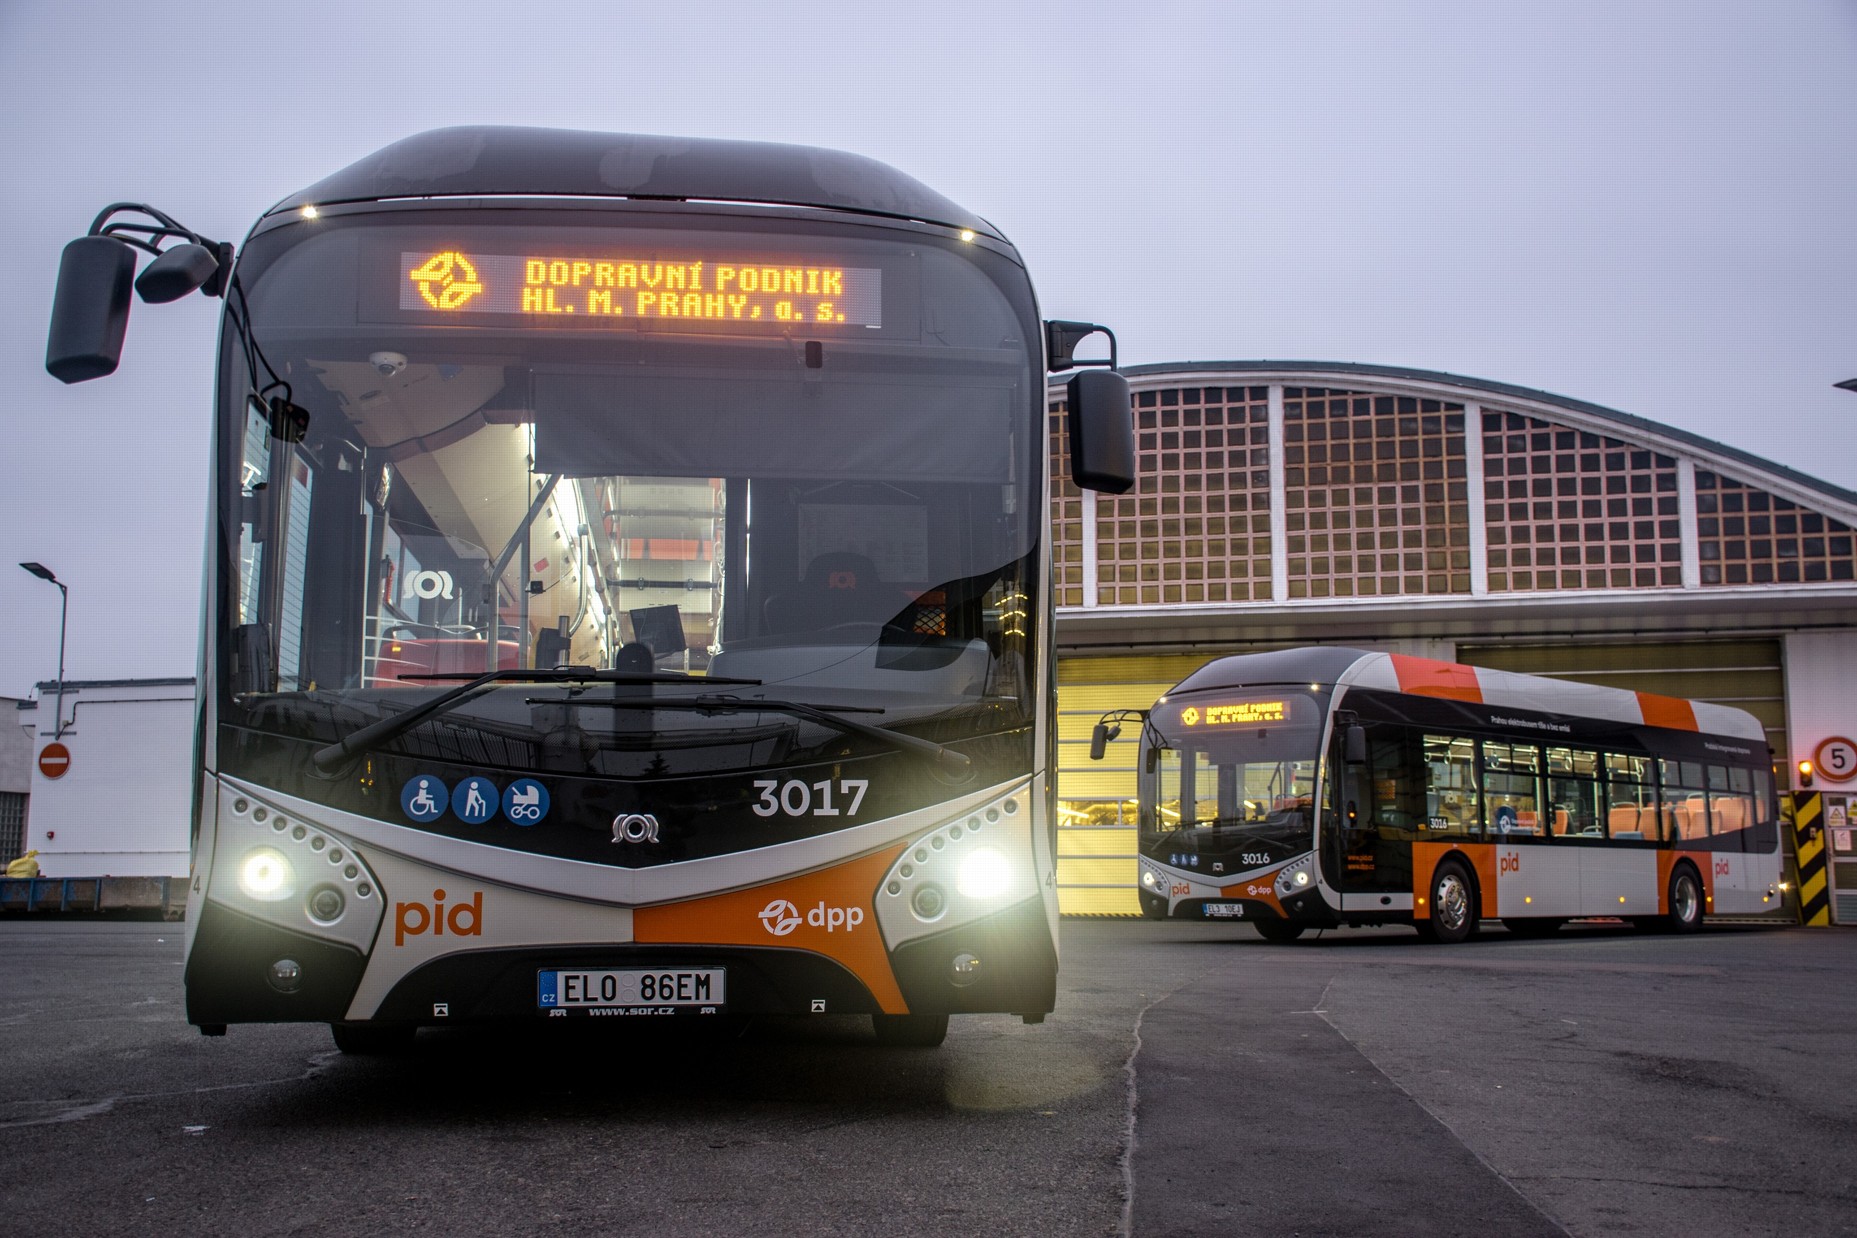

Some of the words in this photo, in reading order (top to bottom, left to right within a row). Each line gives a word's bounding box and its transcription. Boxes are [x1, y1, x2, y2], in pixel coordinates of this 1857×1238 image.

[526, 260, 703, 290] DOPRAVNÍ
[716, 266, 843, 295] PODNIK
[522, 287, 574, 314] HL.
[588, 290, 623, 314] M.
[637, 290, 762, 319] PRAHY,
[816, 302, 845, 323] s.
[1831, 748, 1845, 769] 5
[752, 779, 869, 817] 3017
[1430, 818, 1448, 829] 3016
[1241, 852, 1271, 865] 3016
[1500, 851, 1519, 877] pid
[1715, 858, 1729, 878] pid
[1171, 882, 1190, 897] pid
[1258, 885, 1272, 895] dpp
[395, 888, 483, 946] pid
[807, 901, 864, 932] dpp
[641, 973, 711, 1001] 86EM
[542, 994, 555, 1002] CZ
[589, 1007, 675, 1016] www.sor.cz
